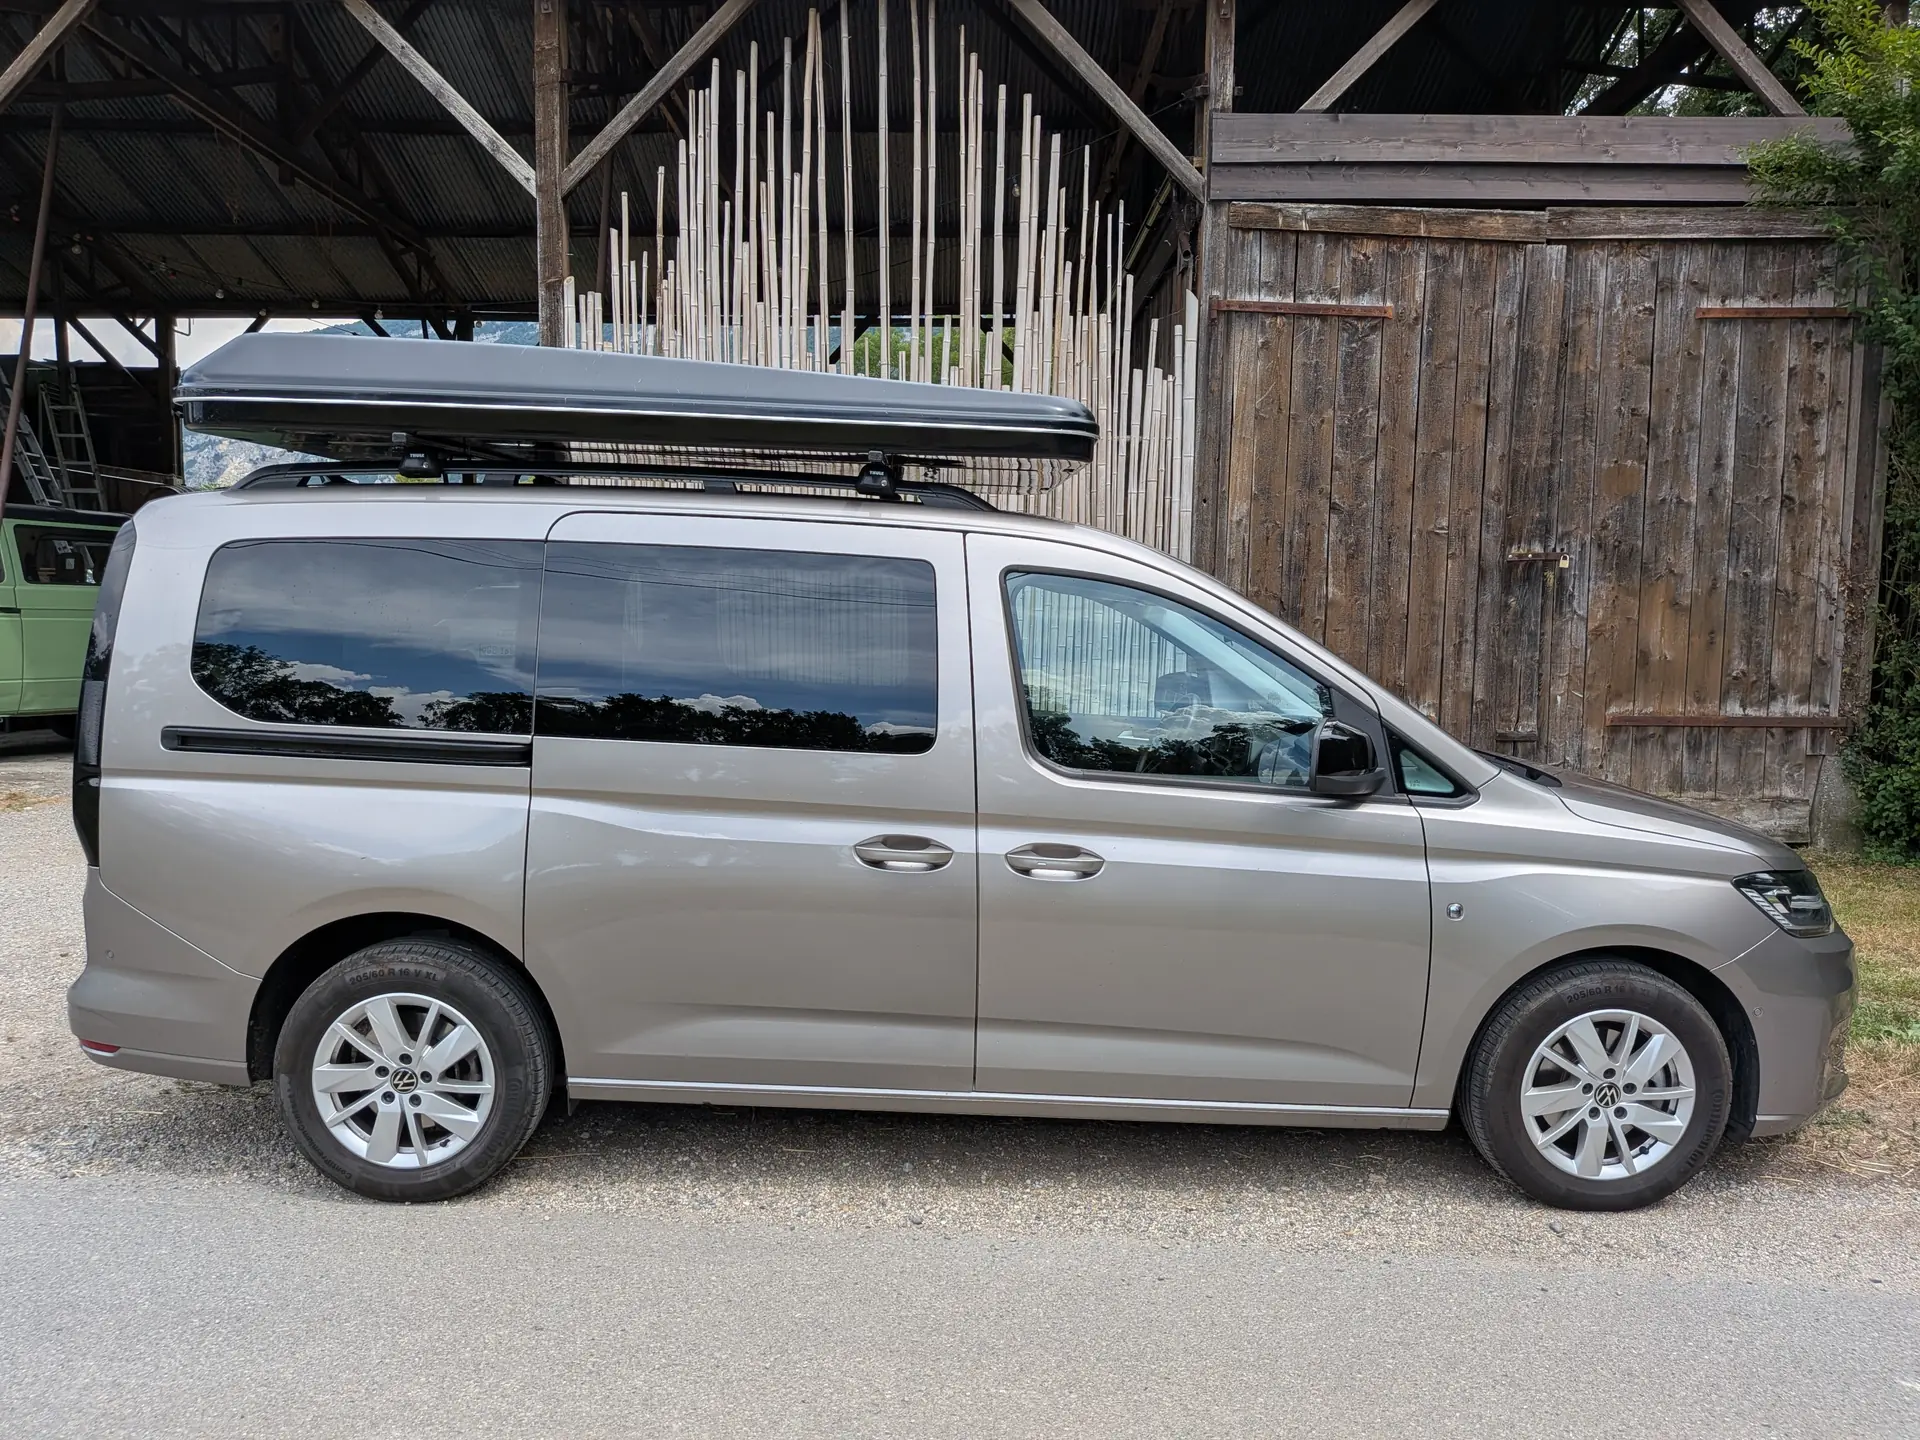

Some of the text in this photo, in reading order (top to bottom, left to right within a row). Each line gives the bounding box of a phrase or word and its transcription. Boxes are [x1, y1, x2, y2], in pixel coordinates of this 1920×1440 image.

[349, 967, 438, 985] 205/60 R 16 V XL
[1566, 987, 1602, 1004] 205/60
[1604, 985, 1612, 994] R
[1686, 1089, 1724, 1168] Continental
